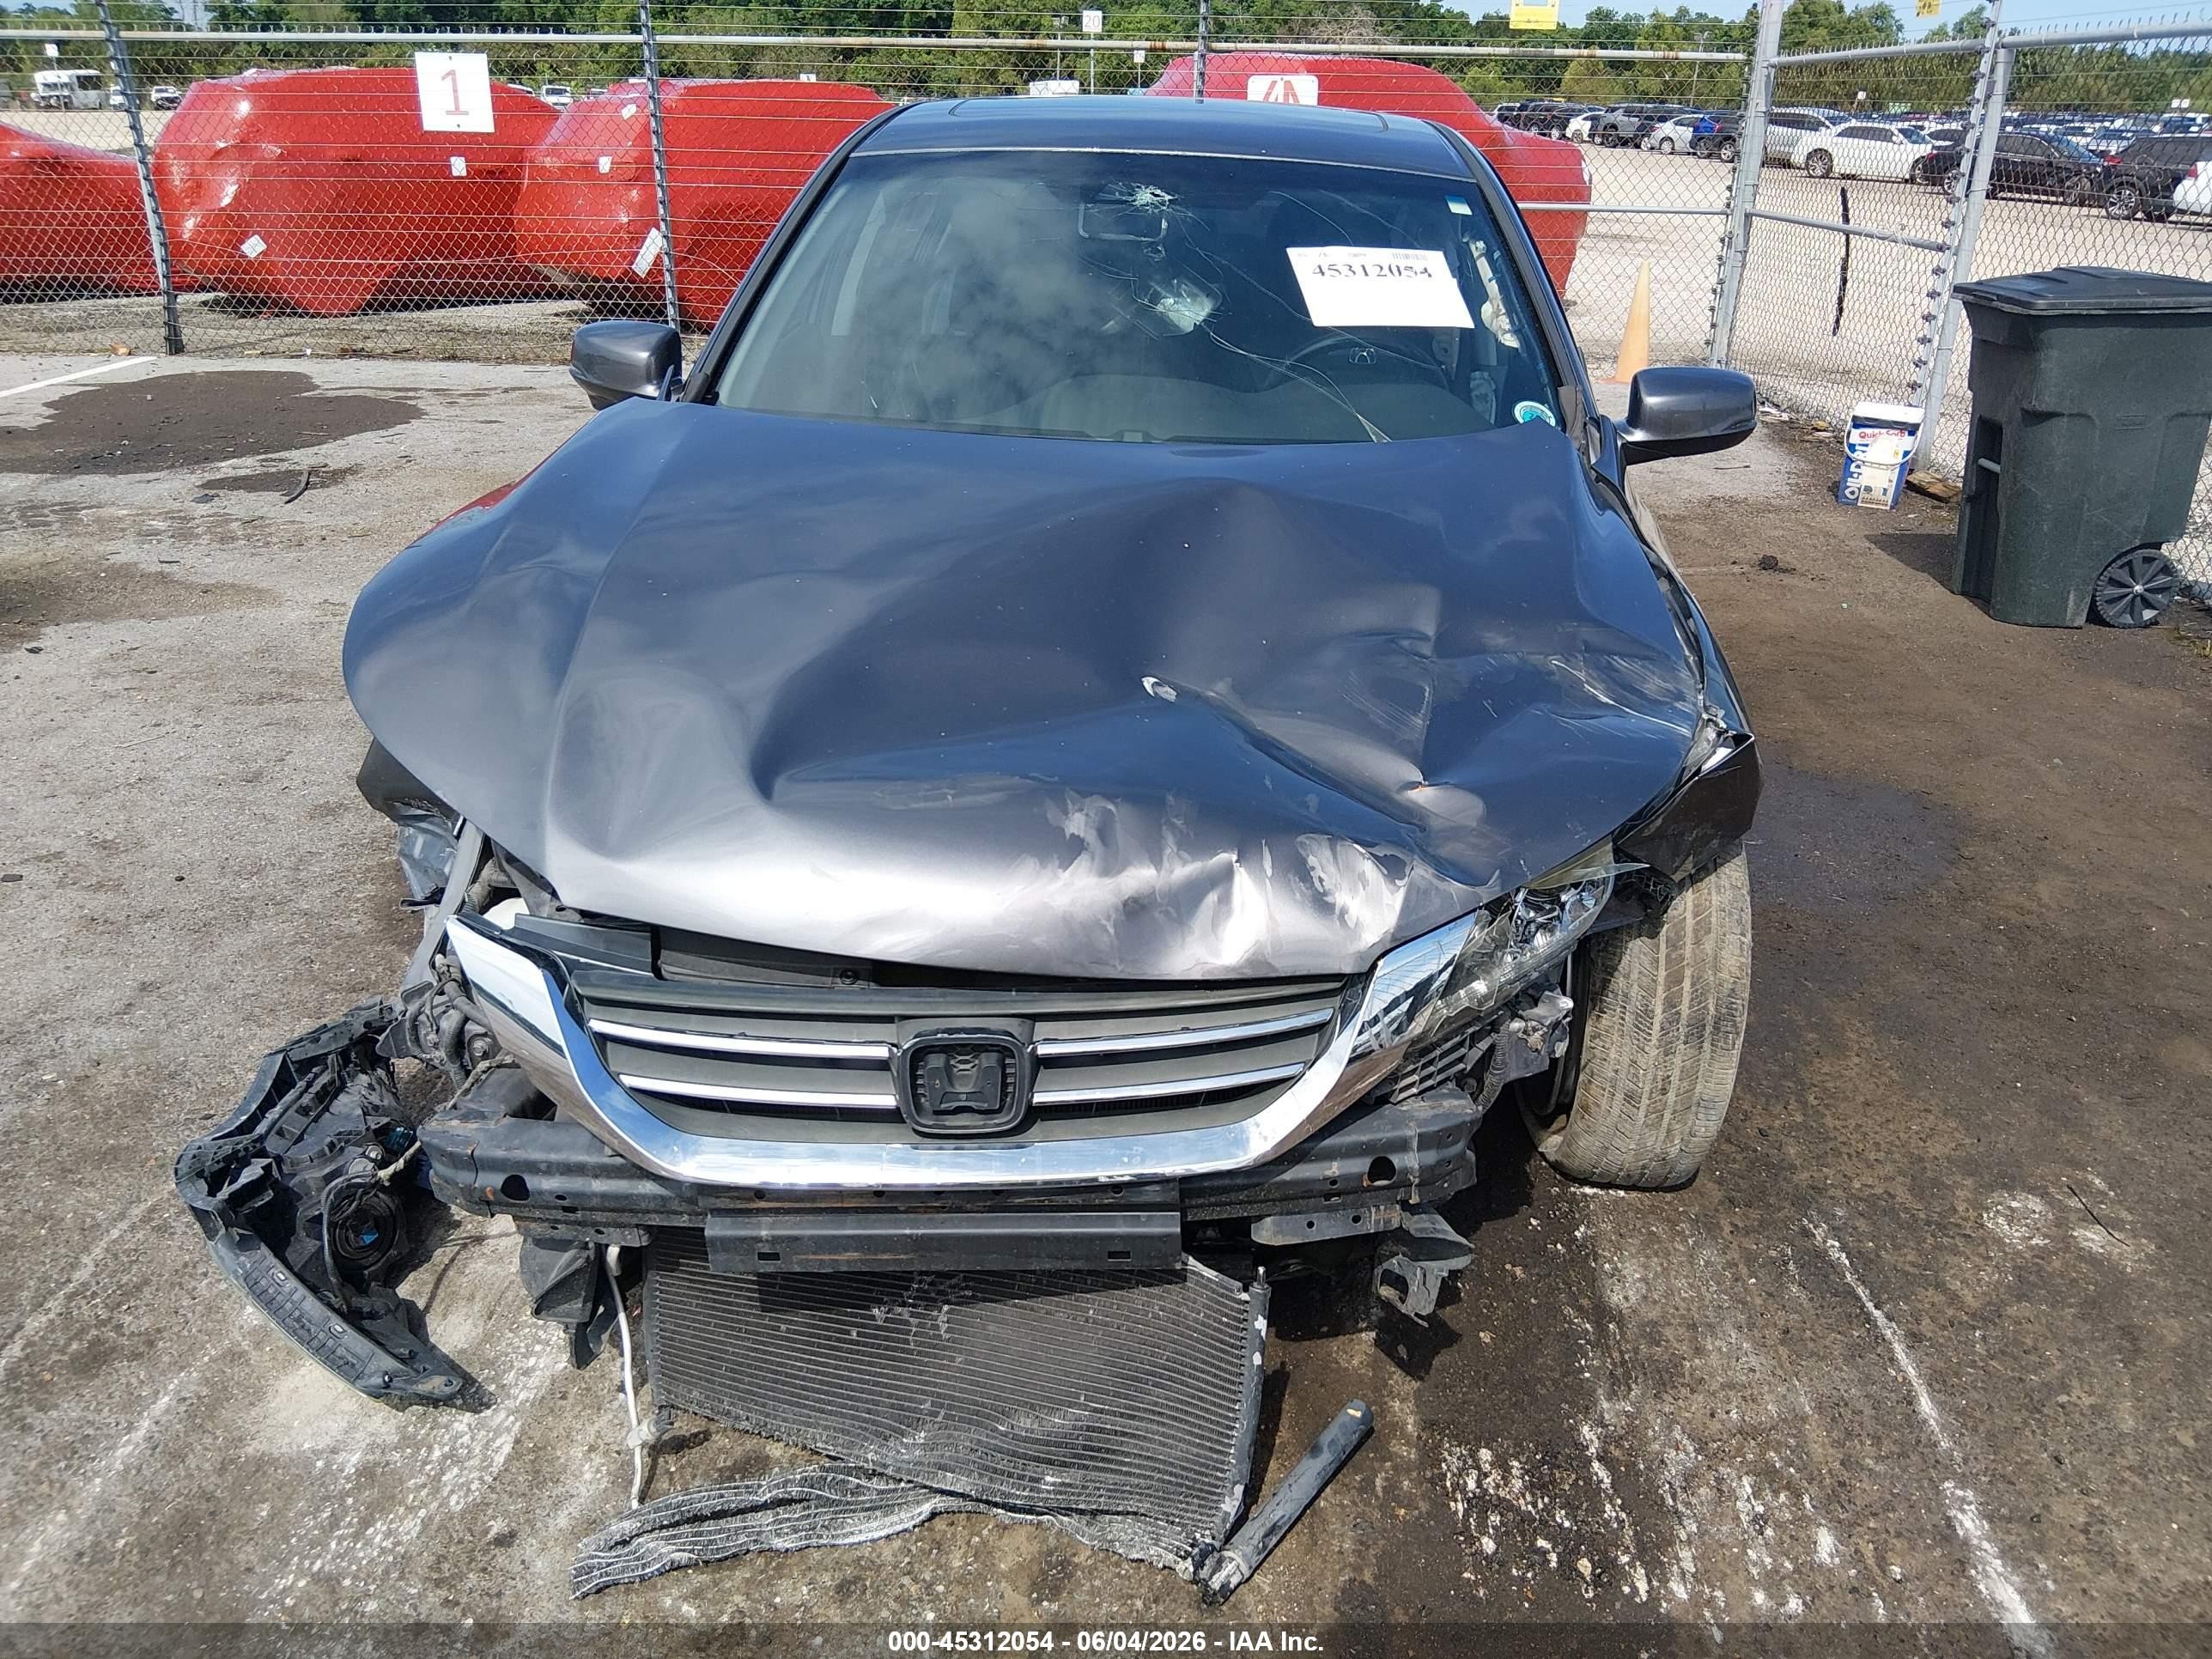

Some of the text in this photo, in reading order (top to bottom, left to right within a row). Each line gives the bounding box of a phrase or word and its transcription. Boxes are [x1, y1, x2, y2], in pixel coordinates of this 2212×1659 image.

[1084, 14, 1100, 28] 20
[441, 69, 470, 116] 1
[1312, 263, 1433, 279] 45312054
